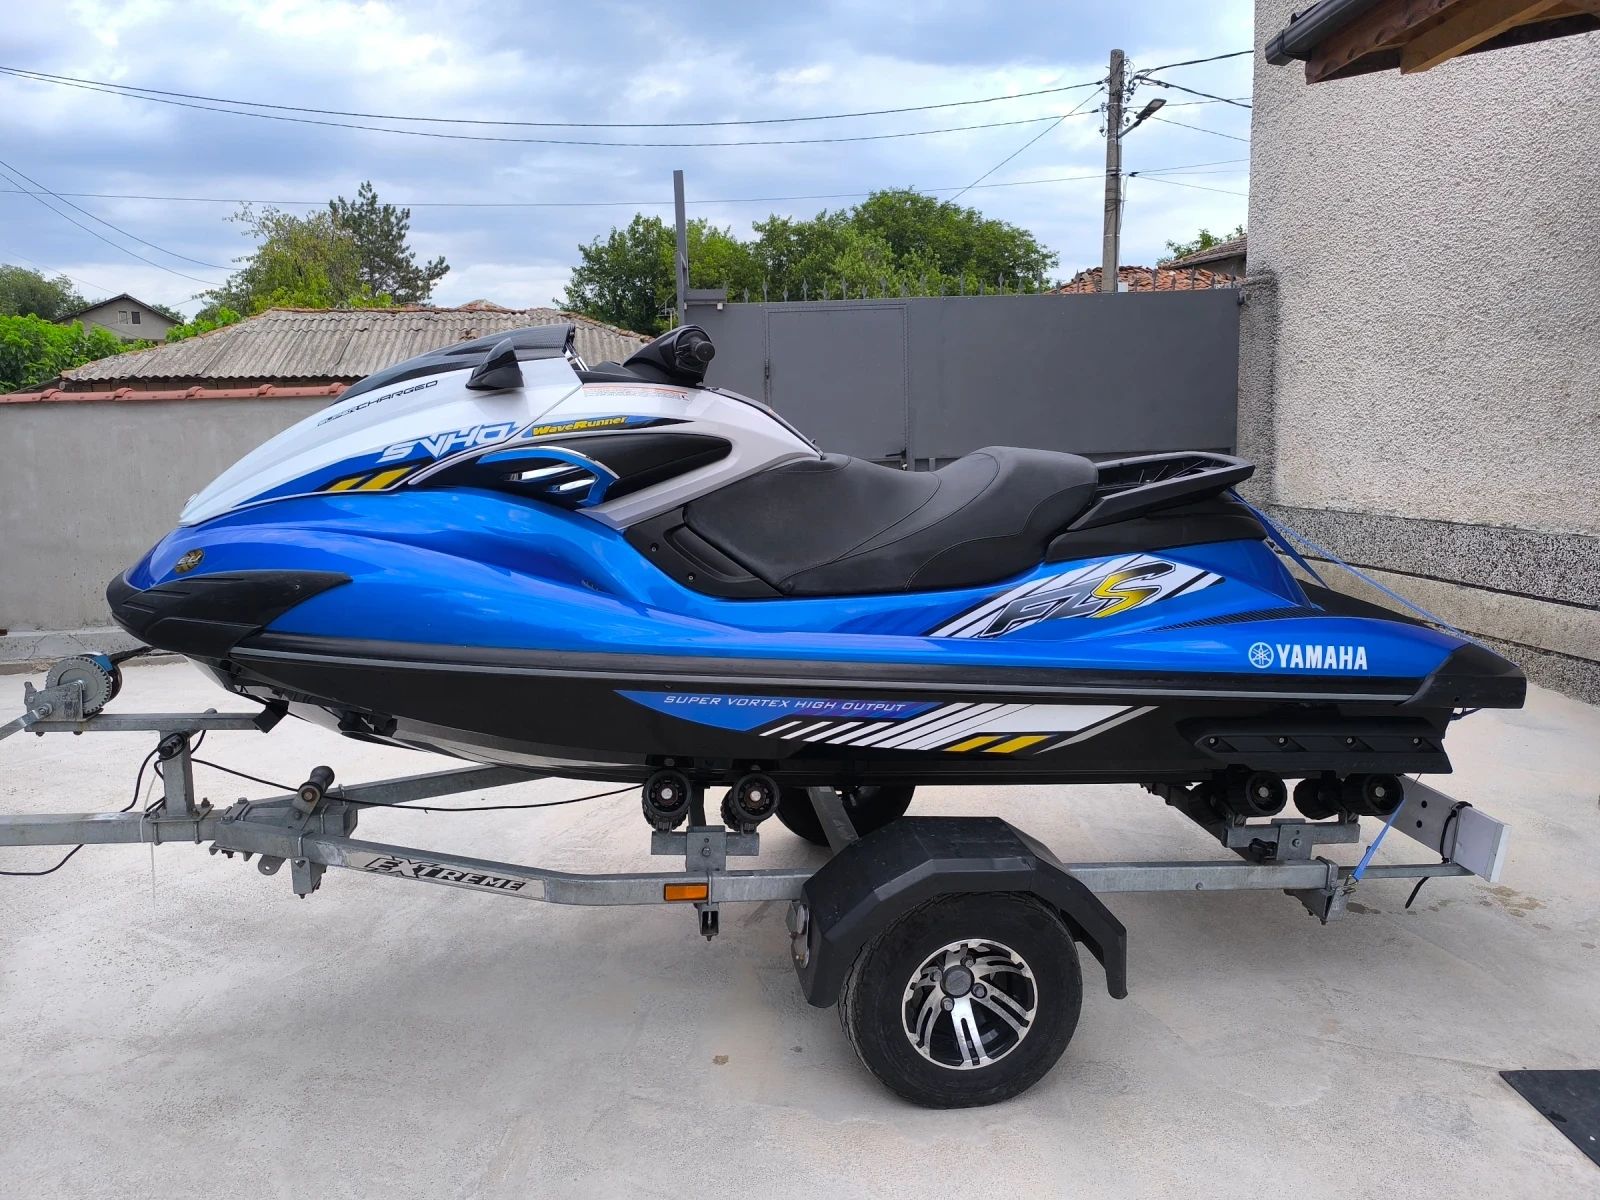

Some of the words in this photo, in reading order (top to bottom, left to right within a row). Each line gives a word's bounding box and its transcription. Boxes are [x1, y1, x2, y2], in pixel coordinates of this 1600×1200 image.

[532, 415, 628, 436] WaveRunner
[375, 423, 515, 463] SVHO
[1276, 644, 1368, 670] YAMAHA
[664, 695, 721, 706] SUPER
[728, 697, 790, 708] VORTEX
[794, 701, 836, 710] HIGH
[842, 702, 906, 712] OUTPUT
[364, 856, 525, 891] EXTREME
